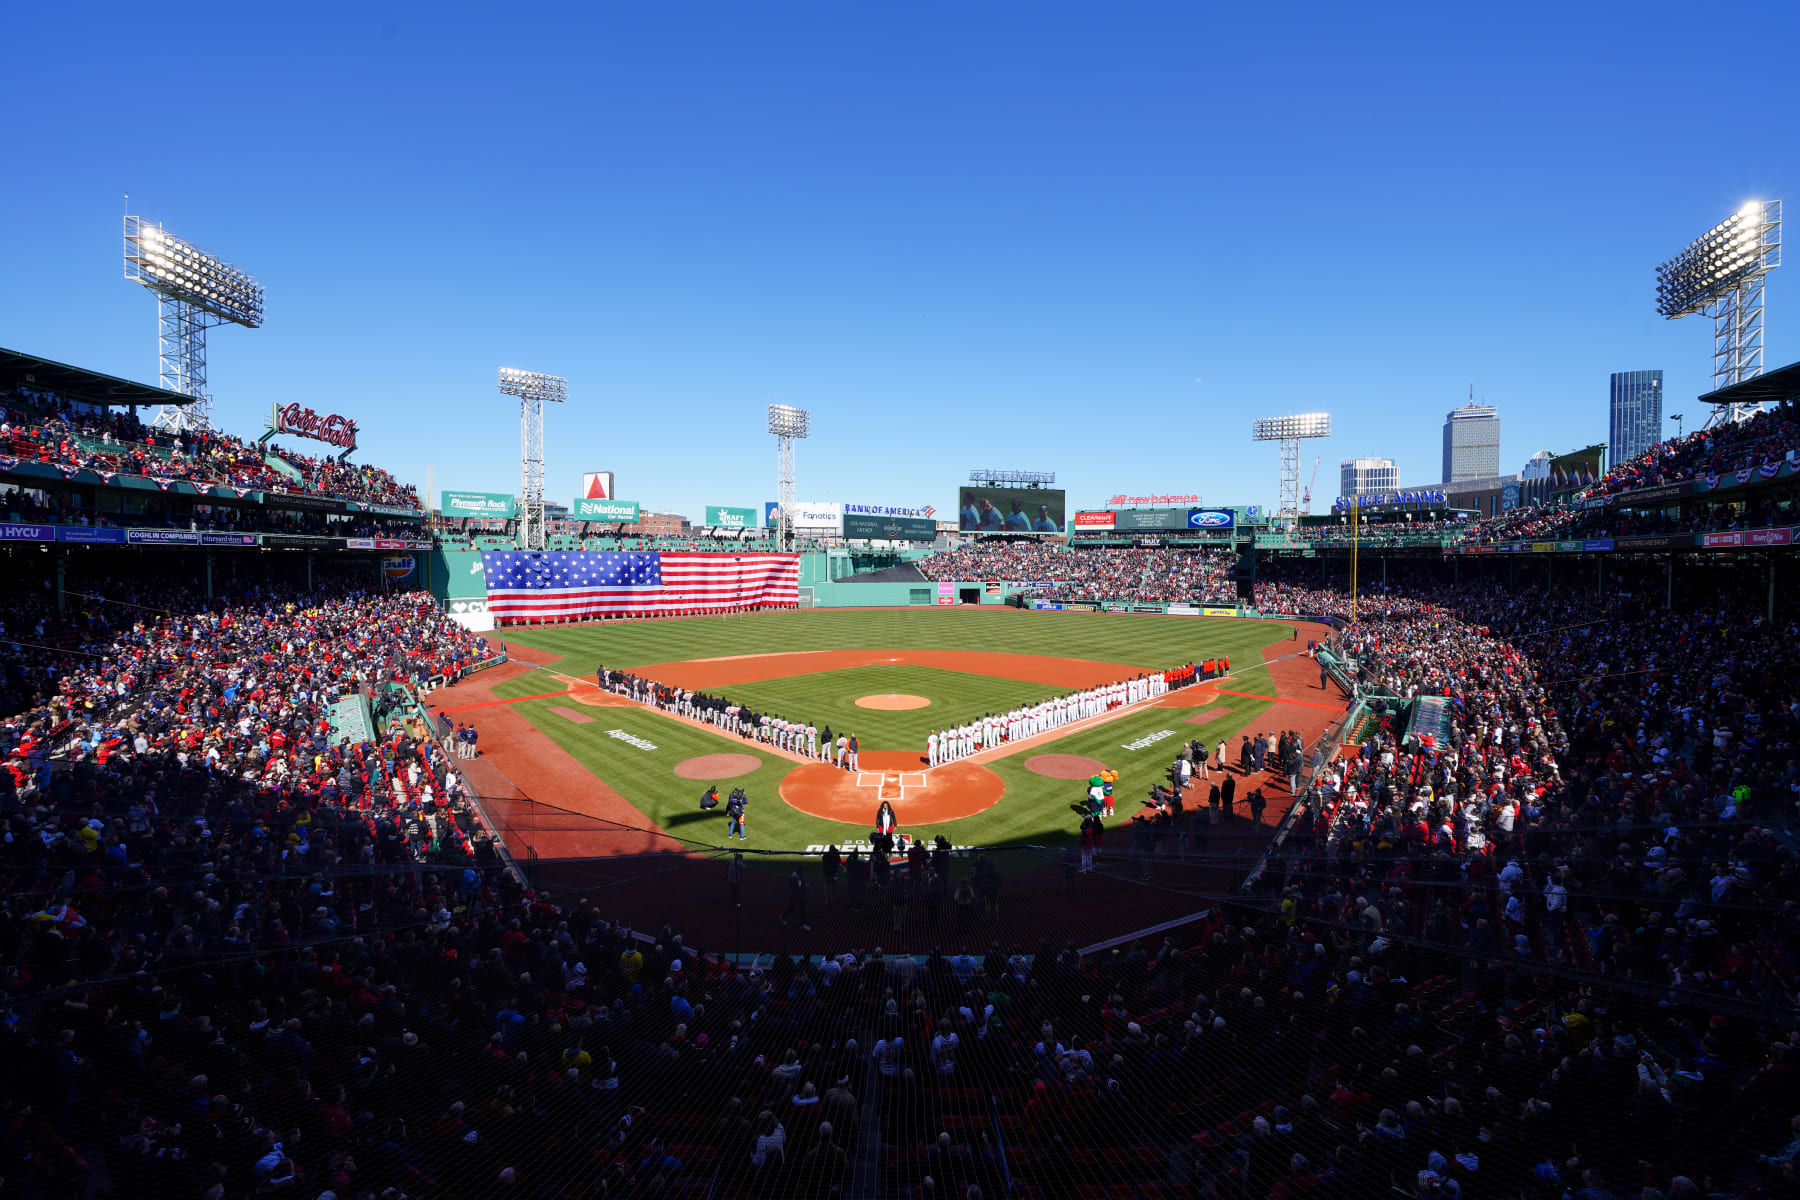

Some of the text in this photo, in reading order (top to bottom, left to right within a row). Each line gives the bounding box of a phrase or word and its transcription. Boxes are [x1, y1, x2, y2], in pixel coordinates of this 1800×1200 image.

[279, 402, 357, 448] Coca-Cola
[451, 498, 506, 508] Plymouth Rock
[1128, 496, 1150, 504] new
[1152, 493, 1198, 504] balance
[1335, 489, 1446, 511] SAMUEL ADAMS
[593, 504, 635, 515] National
[803, 511, 837, 519] Fanatics
[845, 503, 920, 516] BANK OF AMERICA
[5, 527, 39, 538] HYCU
[129, 531, 160, 539] COGHLIN
[160, 532, 197, 540] COMPANIES
[383, 558, 413, 568] Gulf
[468, 601, 489, 613] CV
[603, 728, 658, 751] Aspiration
[1120, 729, 1177, 751] Aspiration
